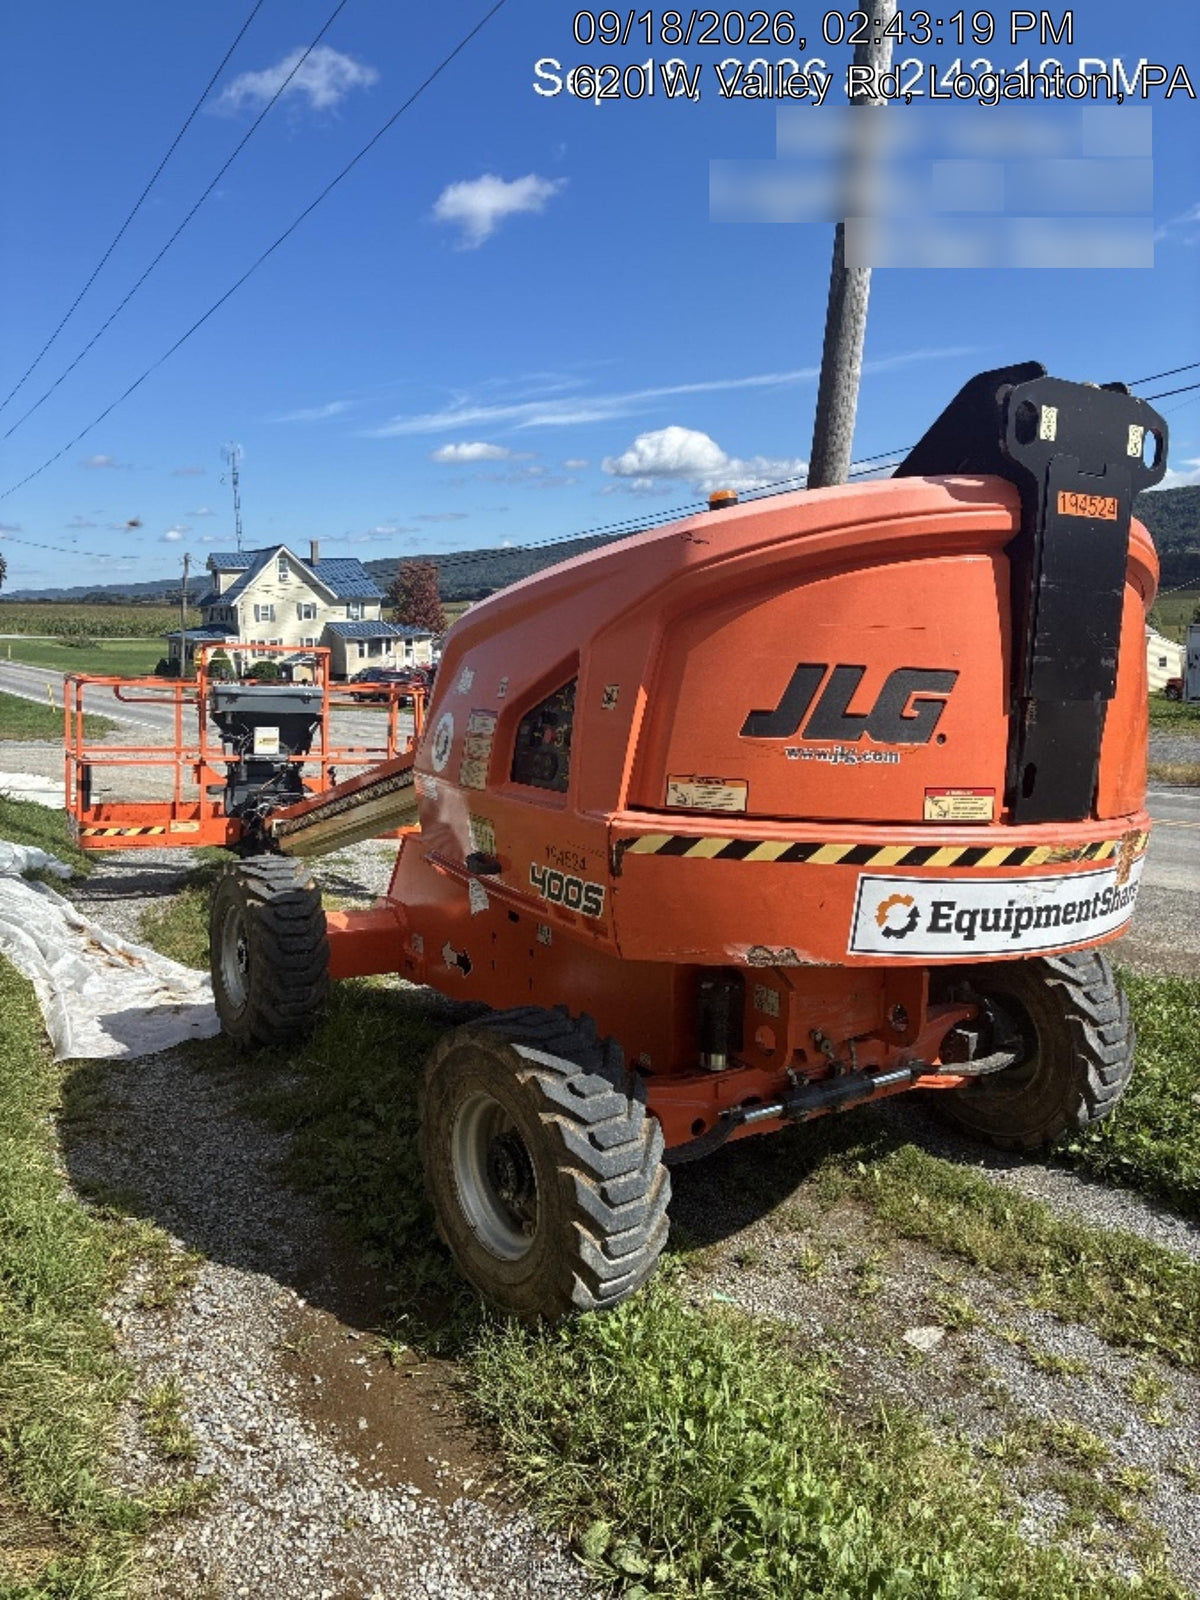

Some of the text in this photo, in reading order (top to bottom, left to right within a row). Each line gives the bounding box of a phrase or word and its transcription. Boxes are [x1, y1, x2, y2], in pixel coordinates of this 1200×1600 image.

[1060, 494, 1116, 518] 194524
[738, 662, 960, 745] JLG
[784, 745, 901, 765] www.jlg.com
[529, 861, 607, 920] 400S
